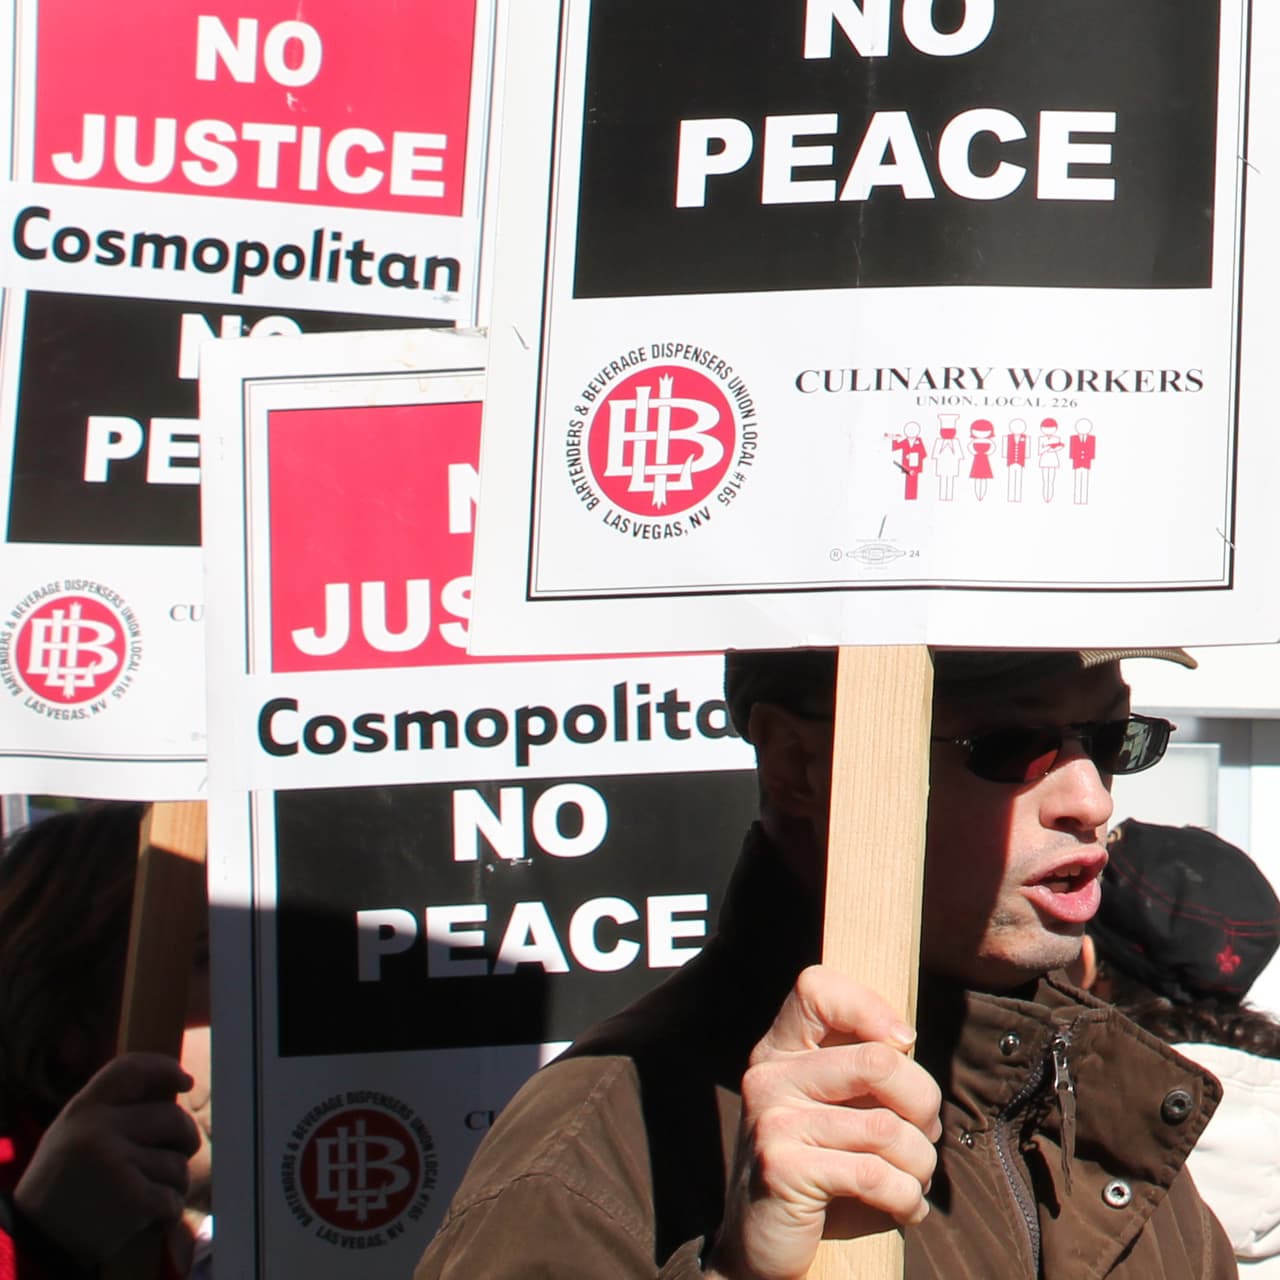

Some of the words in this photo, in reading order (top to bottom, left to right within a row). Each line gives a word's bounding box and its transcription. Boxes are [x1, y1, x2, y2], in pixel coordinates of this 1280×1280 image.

[195, 15, 323, 87] NO
[51, 114, 447, 198] JUSTICE
[676, 108, 1117, 208] PEACE
[12, 205, 460, 295] Cosmopolitan
[582, 347, 647, 403] BEVERAGE
[651, 343, 733, 380] DISPENSERS
[795, 366, 995, 393] CULINARY
[1006, 367, 1204, 393] WORKERS
[575, 405, 589, 416] &
[727, 375, 756, 419] UNION
[984, 396, 1046, 408] LOCAL
[1052, 398, 1078, 408] 226
[566, 419, 600, 511] BARTENDERS
[737, 422, 757, 467] LOCAL
[717, 472, 747, 506] #165
[603, 509, 631, 533] LAS
[689, 506, 711, 529] NV
[258, 681, 740, 768] Cosmopolita
[452, 783, 607, 861] NO
[356, 893, 708, 982] PEACE
